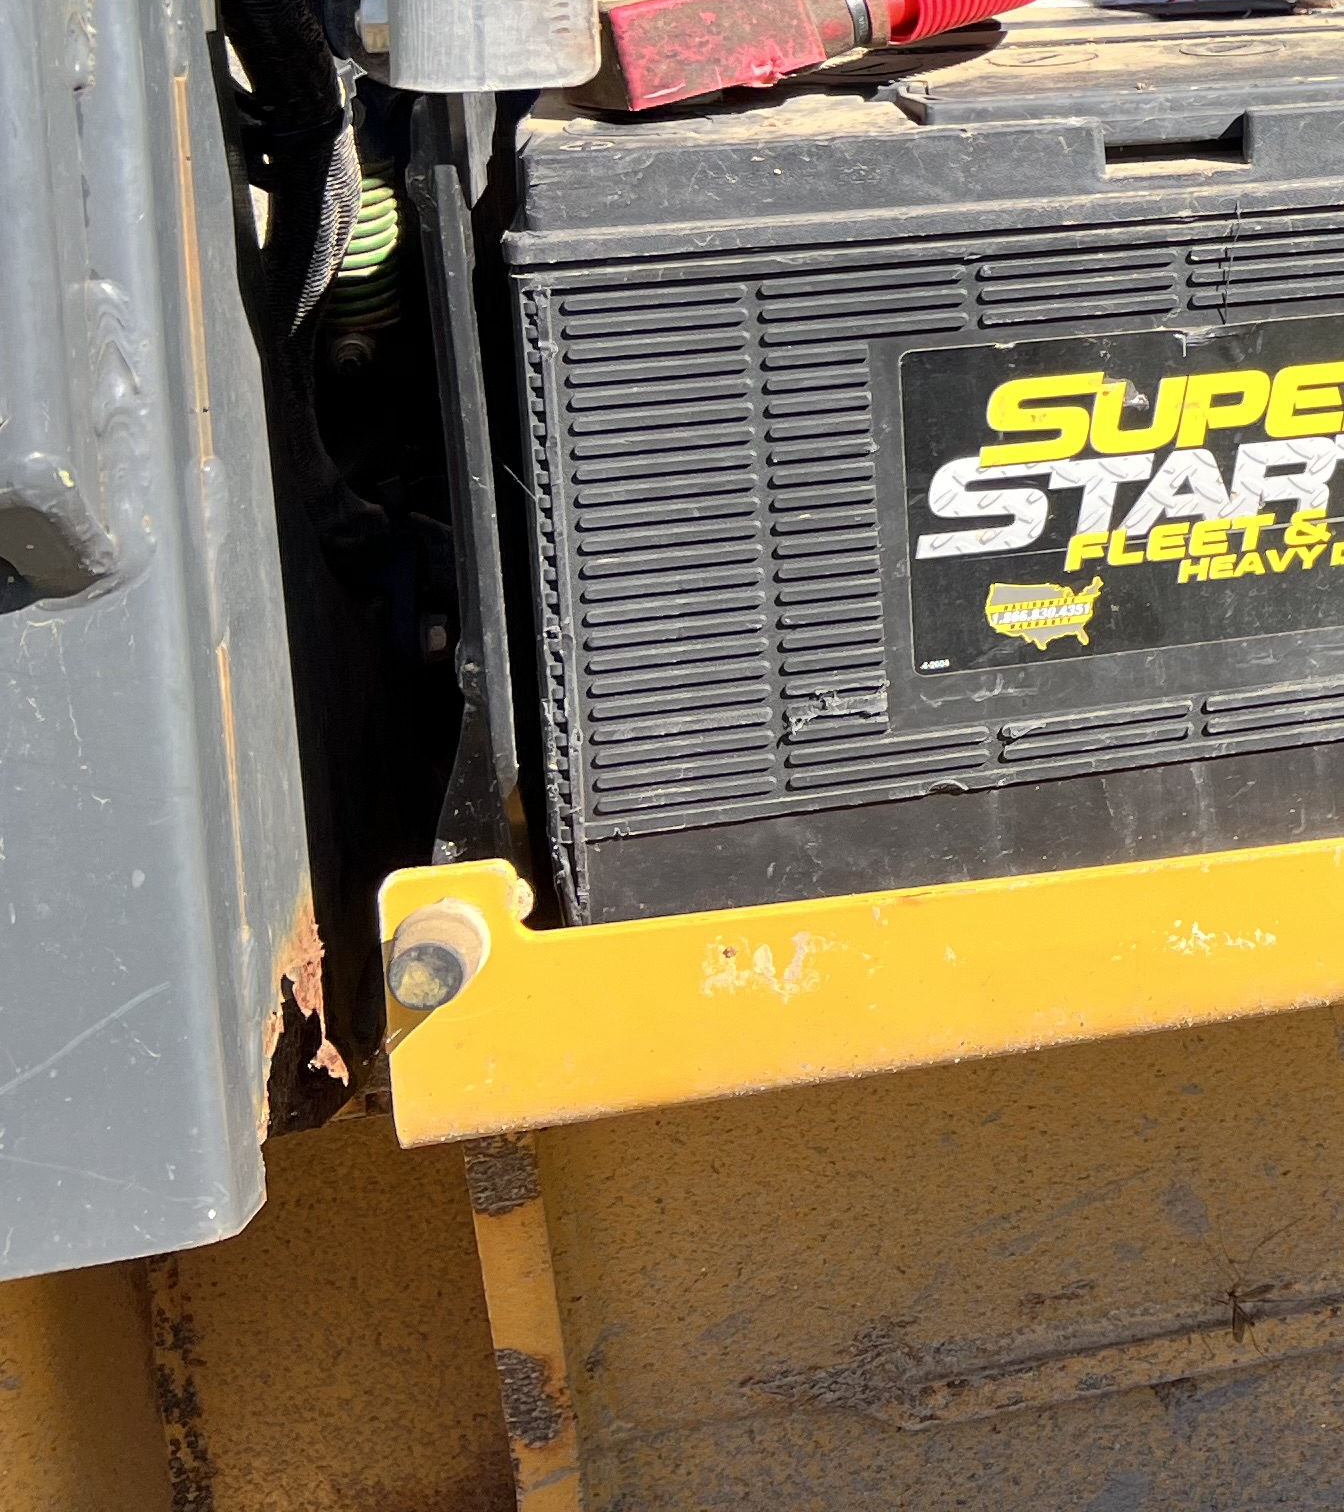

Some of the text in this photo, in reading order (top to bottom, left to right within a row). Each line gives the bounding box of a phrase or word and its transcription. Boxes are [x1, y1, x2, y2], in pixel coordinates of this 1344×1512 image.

[1064, 508, 1332, 572] FLEET &
[1178, 544, 1328, 584] HEAVY
[991, 602, 1092, 626] 1.866.830.4351
